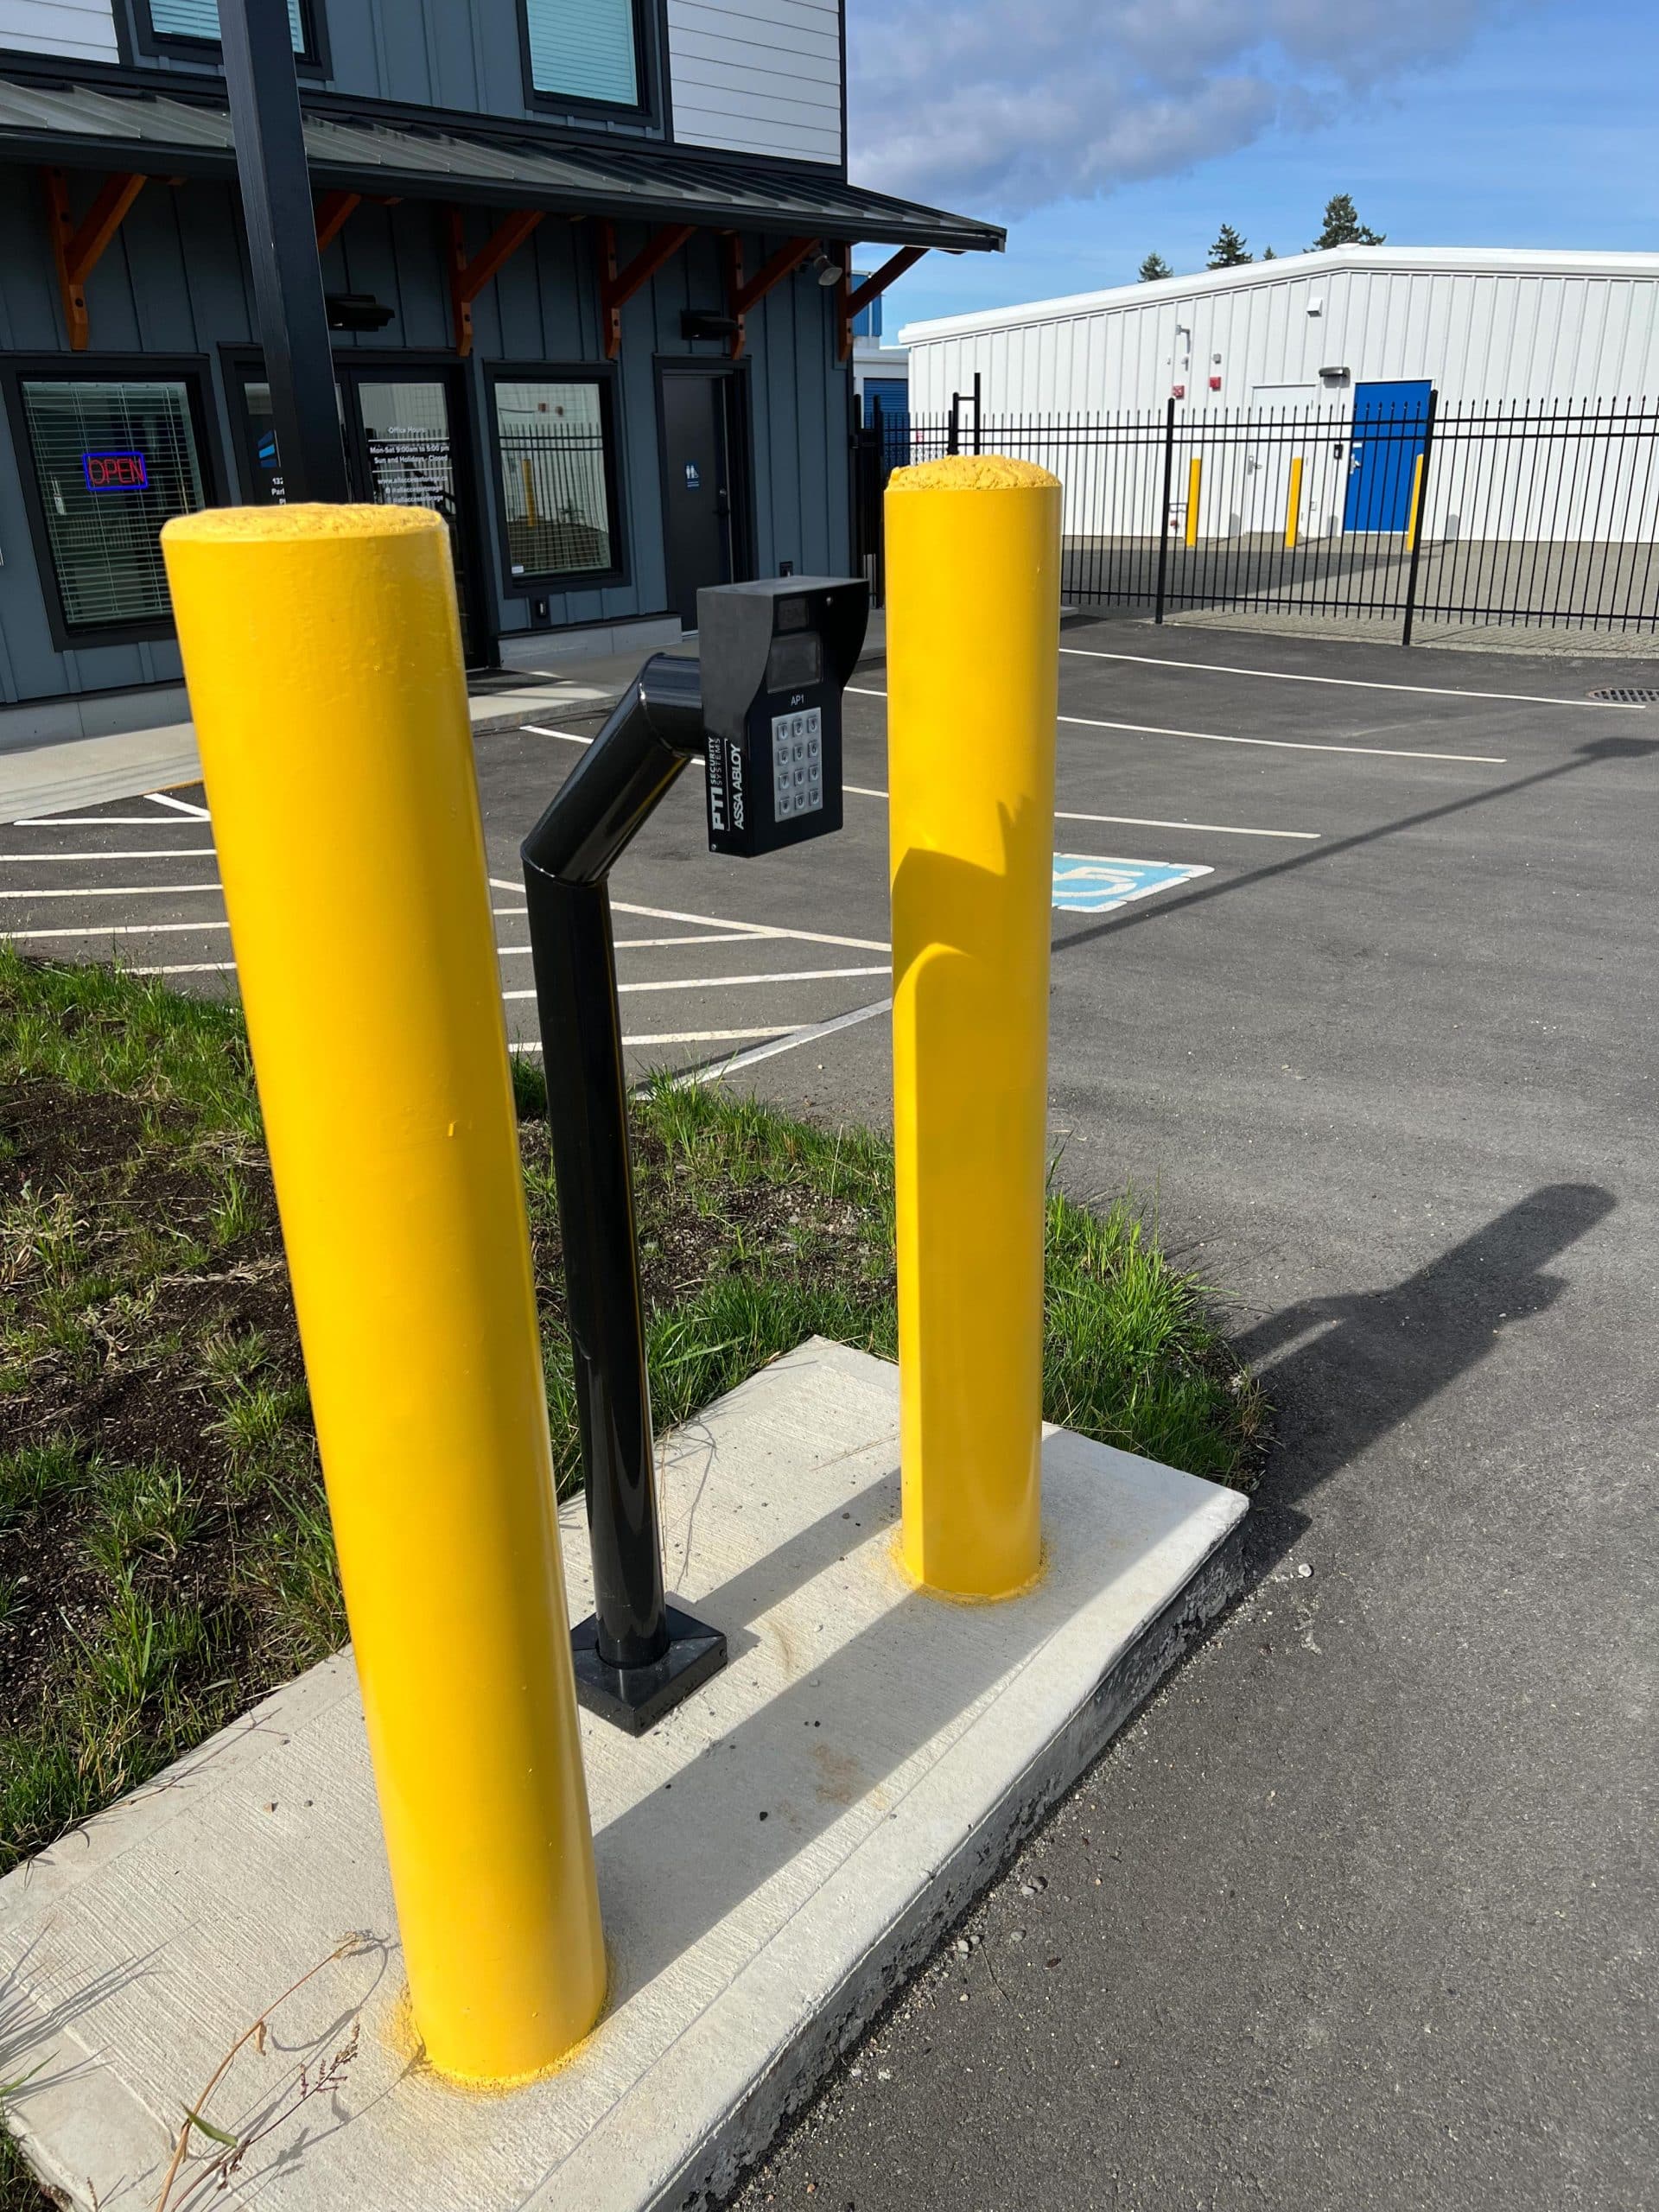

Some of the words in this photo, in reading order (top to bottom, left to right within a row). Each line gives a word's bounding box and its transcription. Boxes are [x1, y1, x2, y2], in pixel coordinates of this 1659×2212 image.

[88, 458, 144, 485] OPEN
[791, 694, 804, 706] AP1
[715, 738, 723, 785] SYSTEMS
[730, 743, 742, 792] ABLOY
[710, 786, 725, 830] PTI
[733, 792, 744, 830] ASSA
